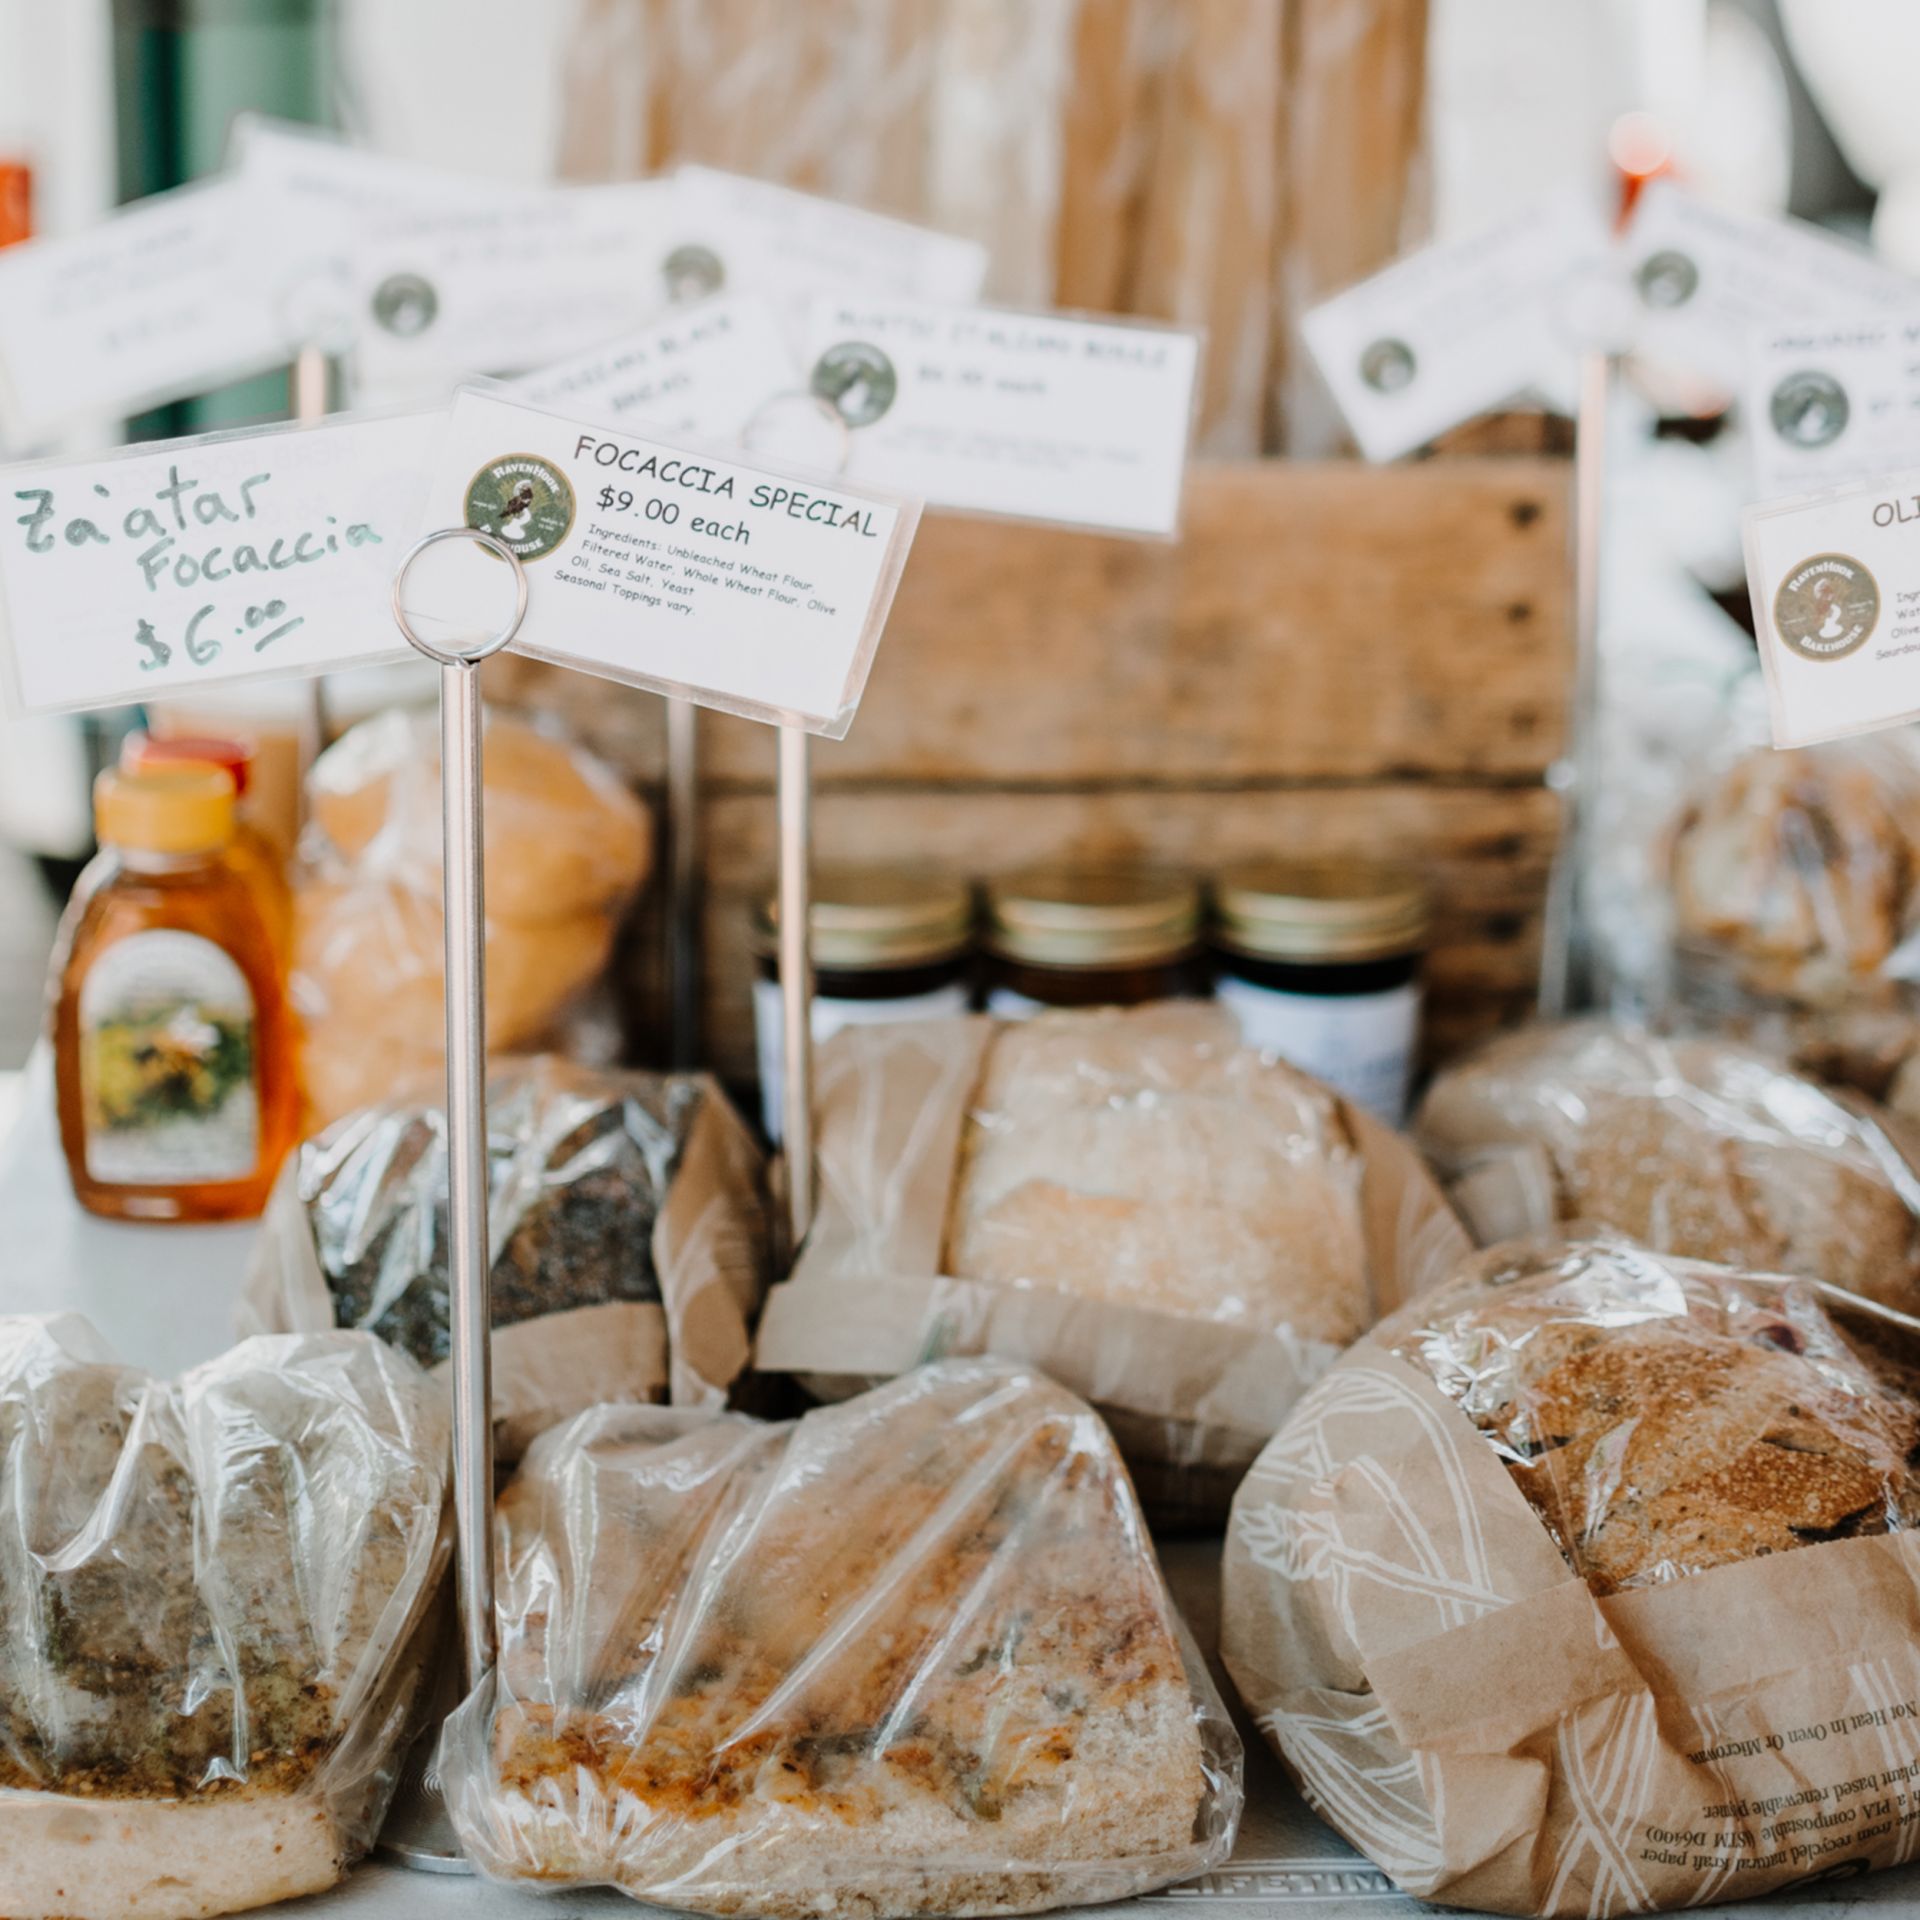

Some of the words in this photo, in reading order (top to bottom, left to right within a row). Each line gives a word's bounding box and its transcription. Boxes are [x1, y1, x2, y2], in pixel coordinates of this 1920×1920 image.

[574, 435, 734, 499] FOCACCIA
[750, 485, 877, 537] SPECIAL
[596, 484, 681, 525] $9.00
[690, 517, 751, 546] each
[137, 516, 383, 592] Focaccia
[588, 523, 661, 551] Ingredients:
[667, 544, 734, 571] Unbleached
[740, 562, 778, 583] Wheat
[553, 569, 607, 592] Seasonal
[612, 583, 662, 608] Toppings
[581, 539, 630, 562] Filtered
[683, 566, 719, 587] Whole
[724, 576, 764, 598] Wheat
[807, 598, 837, 616] Olive
[598, 563, 621, 579] Sea
[661, 578, 695, 597] Yeast
[1852, 1709, 1888, 1731] Heat
[1892, 1700, 1918, 1721] Not
[1787, 1724, 1828, 1743] Oven
[1830, 1718, 1850, 1736] In
[1766, 1734, 1785, 1751] Or
[1881, 1759, 1920, 1787] plant
[1834, 1775, 1880, 1802] based
[1898, 1794, 1907, 1806] a
[1752, 1788, 1830, 1819] renewable
[1862, 1798, 1892, 1820] PLA
[1644, 1826, 1708, 1848] D6400)
[1761, 1809, 1857, 1843] compostable
[1857, 1820, 1893, 1843] from
[1640, 1848, 1689, 1867] paper
[1735, 1850, 1787, 1873] natural
[1790, 1834, 1852, 1866] recycled
[1692, 1854, 1730, 1873] kraft
